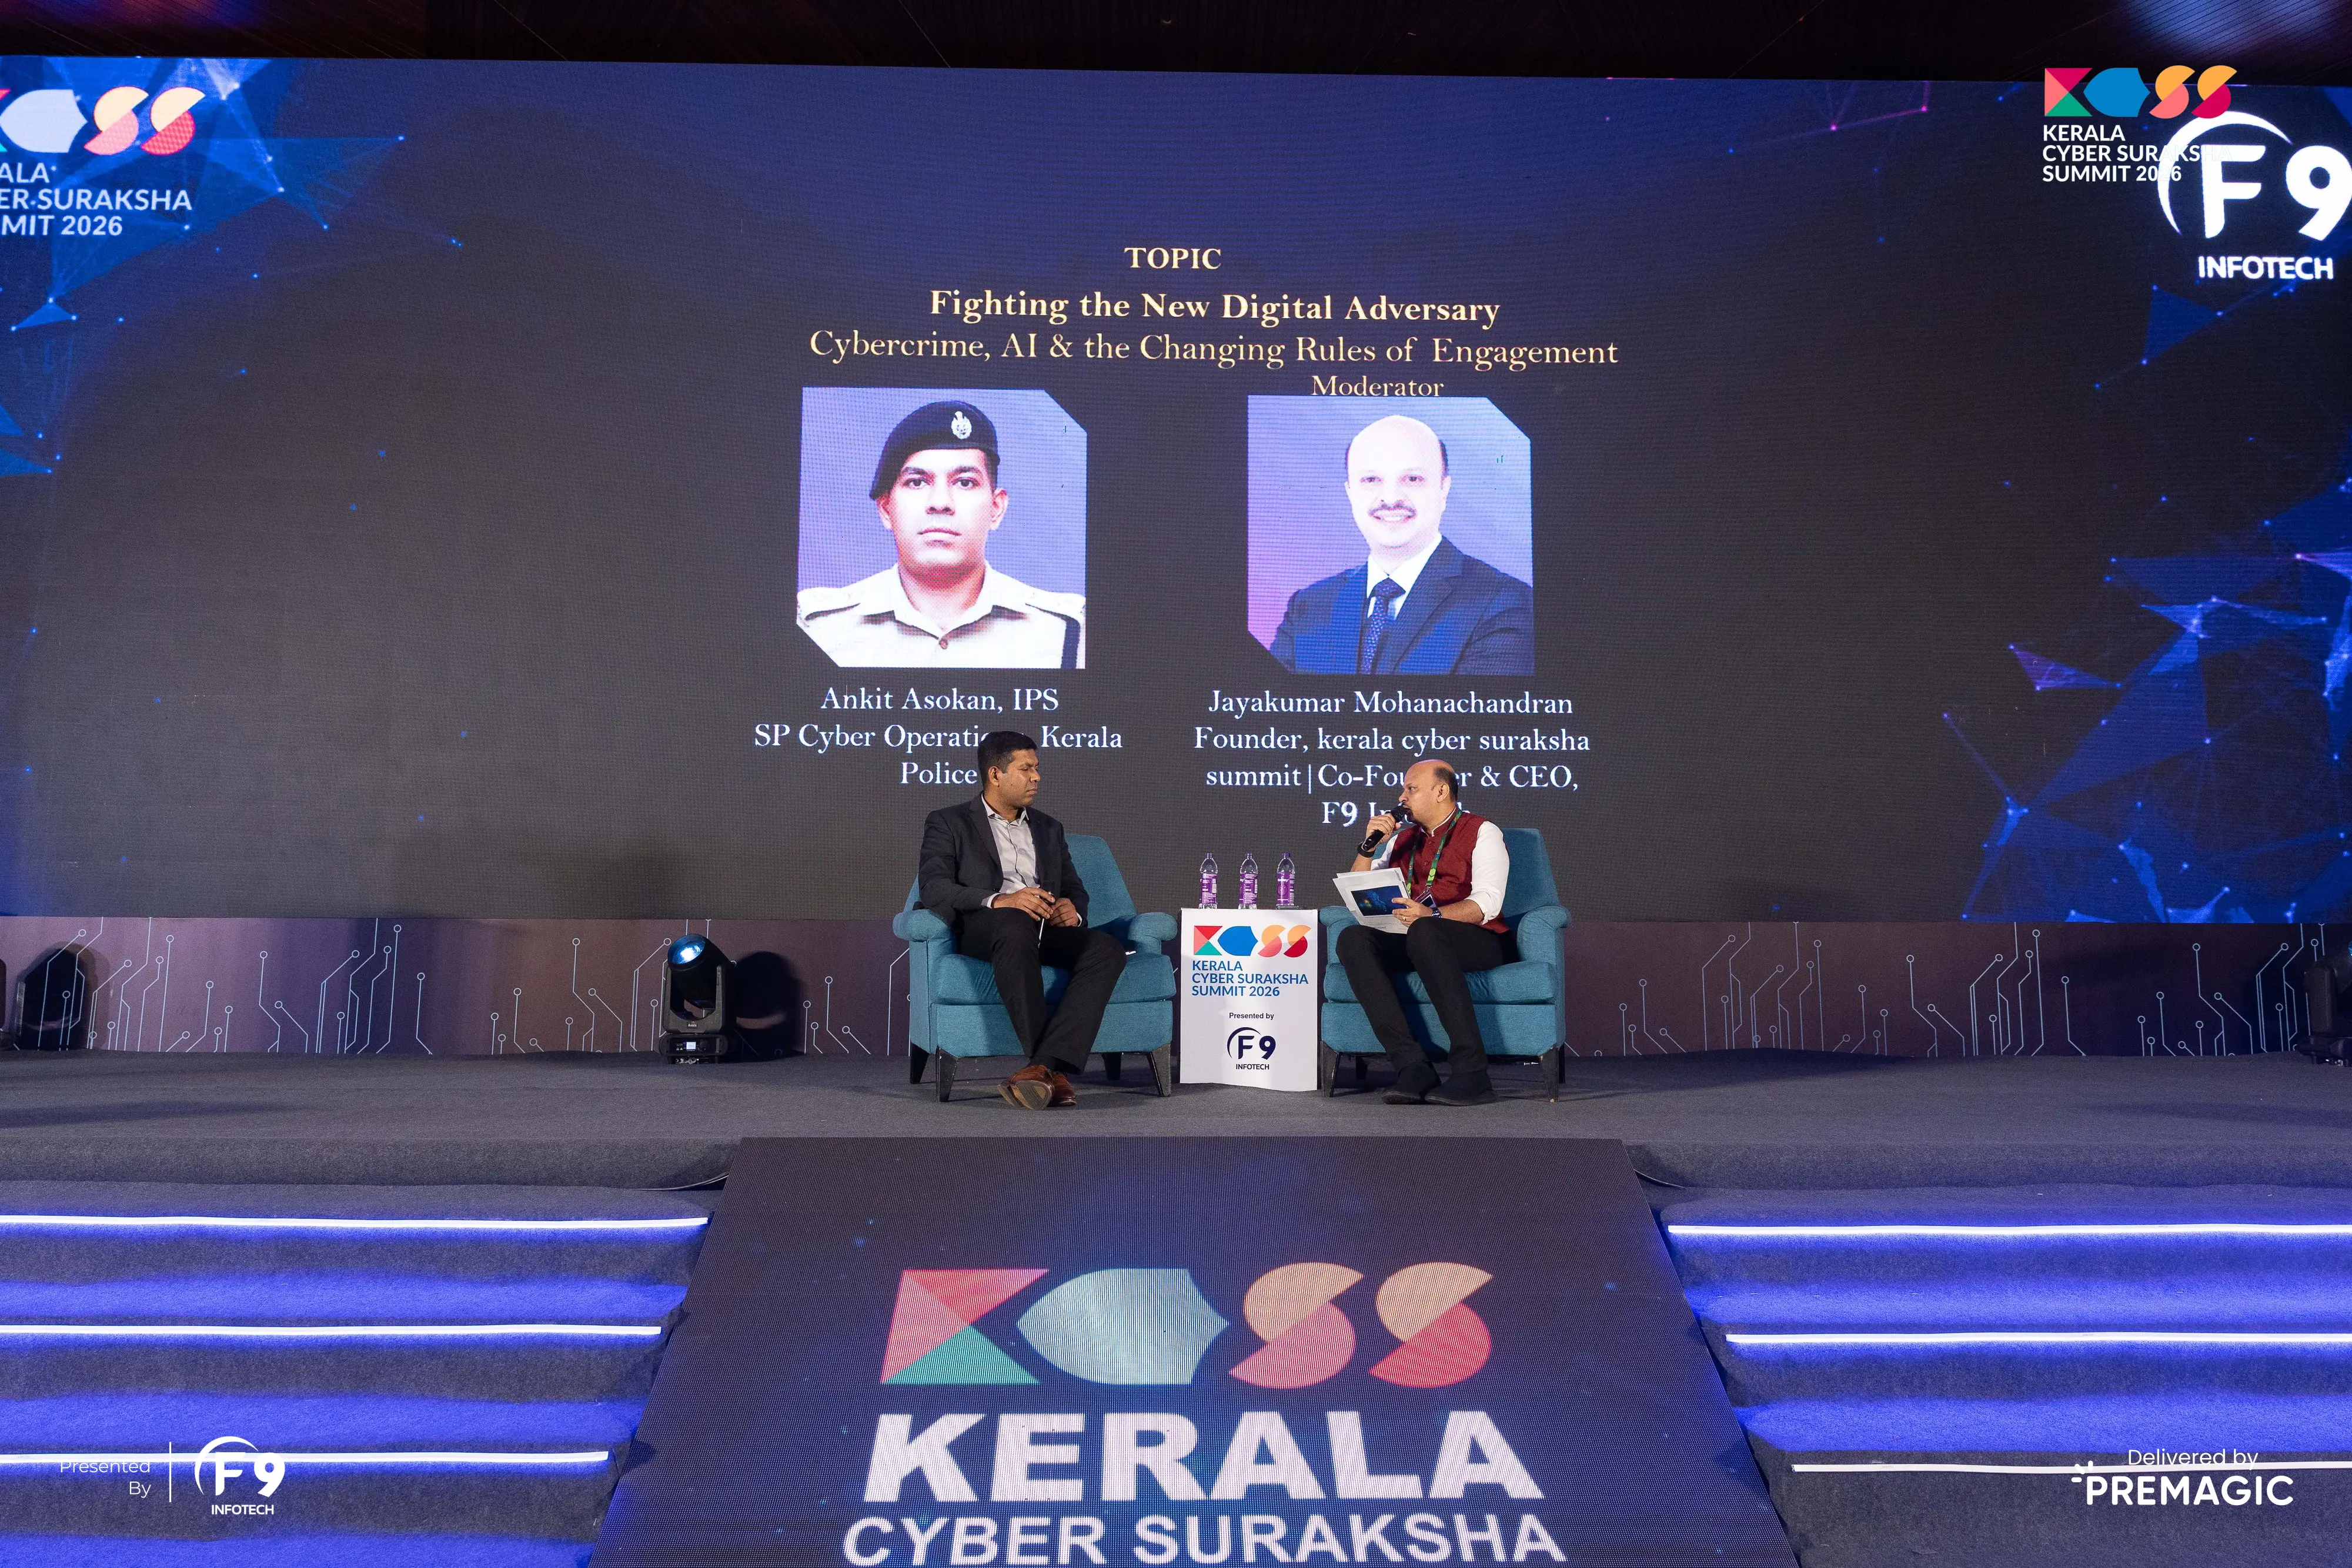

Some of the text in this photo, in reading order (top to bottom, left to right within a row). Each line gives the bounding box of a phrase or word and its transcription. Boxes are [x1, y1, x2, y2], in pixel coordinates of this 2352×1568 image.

[38, 188, 192, 210] SURAKSHA
[61, 215, 123, 236] 2026
[1124, 247, 1222, 270] TOPIC
[2198, 256, 2334, 280] INFOTECH
[930, 289, 1501, 331] Fighting the New Digital Adversary
[810, 329, 1619, 372] Cybercrime, AI & the Changing Rules of Engagement
[1311, 375, 1445, 397] Moderator
[820, 686, 1060, 713] Ankit Asokan, IPS
[1208, 690, 1573, 720] Jayakumar Mohanachandran
[754, 724, 1123, 754] SP Cyber Operati Kerala
[1194, 727, 1591, 758] Founder, kerala cyber suraksha
[901, 761, 978, 784] Police
[1205, 764, 1302, 787] summit
[1480, 765, 1501, 788] &
[1509, 765, 1579, 791] CEO,
[1321, 801, 1359, 828] F9
[1191, 972, 1309, 985] CYBER SURAKSHA
[1192, 960, 1243, 972] KERALA
[1191, 985, 1281, 997] SUMMIT 2026
[1265, 1012, 1275, 1021] by
[863, 1410, 1545, 1503] KERALA
[843, 1513, 1568, 1566] CYBER SURAKSHA
